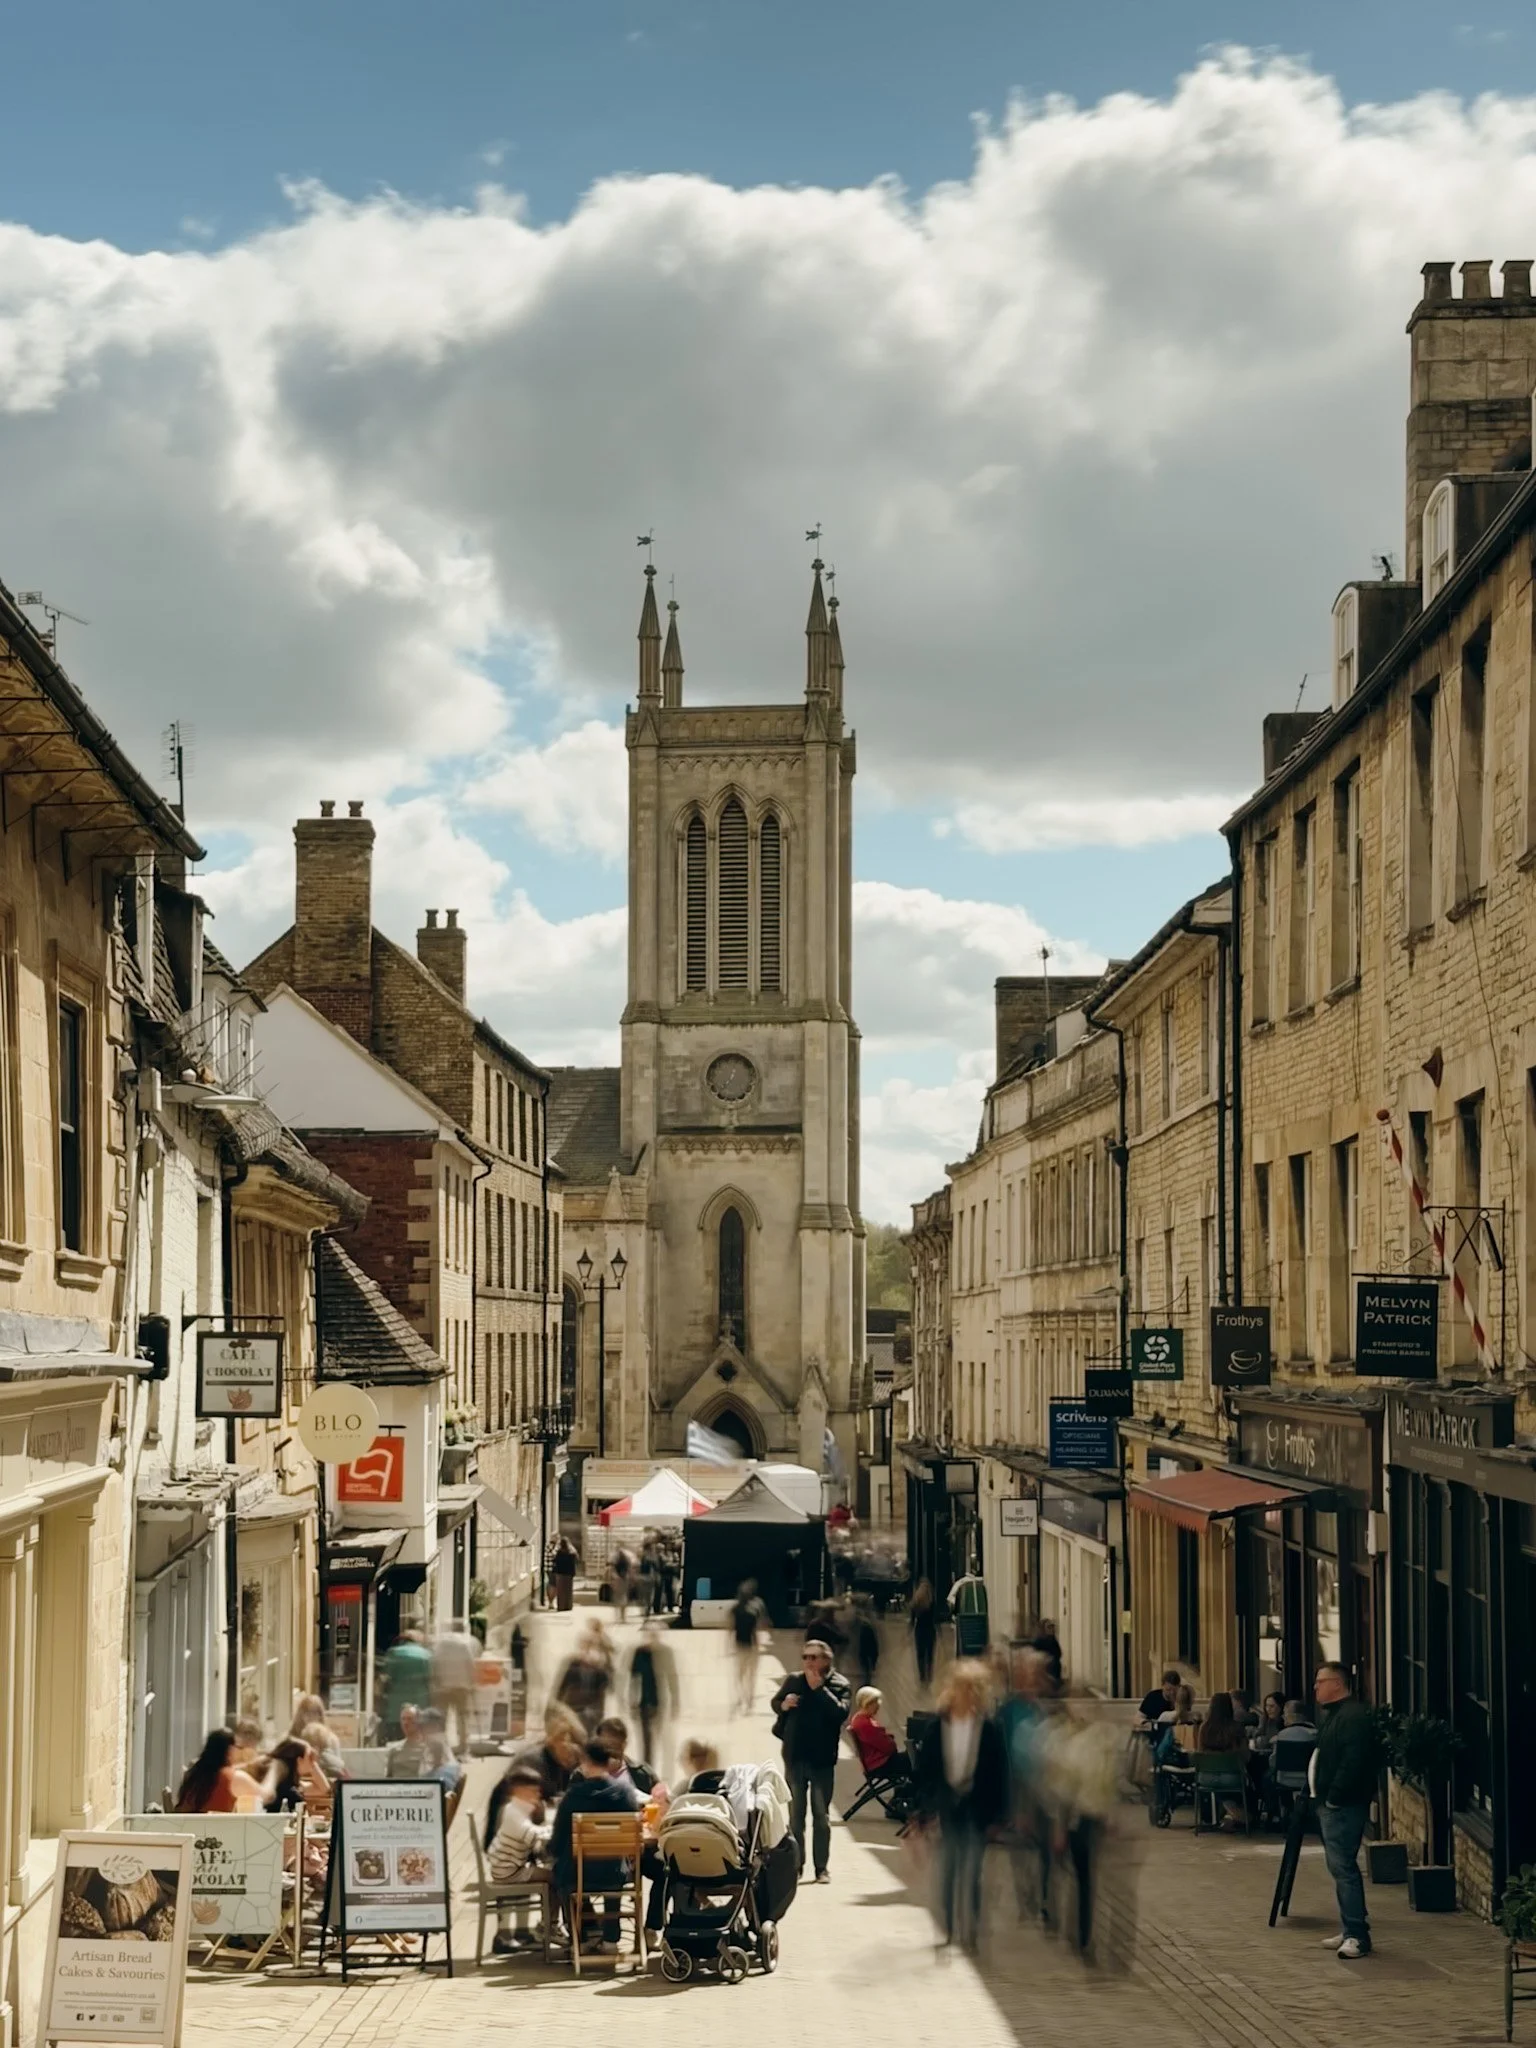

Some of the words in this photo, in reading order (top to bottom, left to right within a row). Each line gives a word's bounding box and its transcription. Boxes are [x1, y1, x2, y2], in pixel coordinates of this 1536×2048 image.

[1365, 1295, 1431, 1309] MELVYN
[1216, 1314, 1264, 1330] Frothys
[1363, 1311, 1432, 1326] PATRICK
[1361, 1348, 1397, 1356] PREMIUM
[1398, 1349, 1431, 1357] BARBER
[206, 1367, 274, 1377] CHOCOLAT
[315, 1413, 362, 1431] BLO
[1395, 1400, 1431, 1440] MELVYN
[1432, 1406, 1476, 1450] PATRICK
[1284, 1423, 1316, 1477] Frothys
[350, 1803, 435, 1824] CRÊPERIE
[193, 1850, 233, 1864] AFE
[71, 1950, 115, 1963] Artisan
[117, 1951, 153, 1964] Bread
[58, 1965, 93, 1978] Cakes
[95, 1967, 106, 1979] &
[107, 1968, 166, 1981] Savouries
